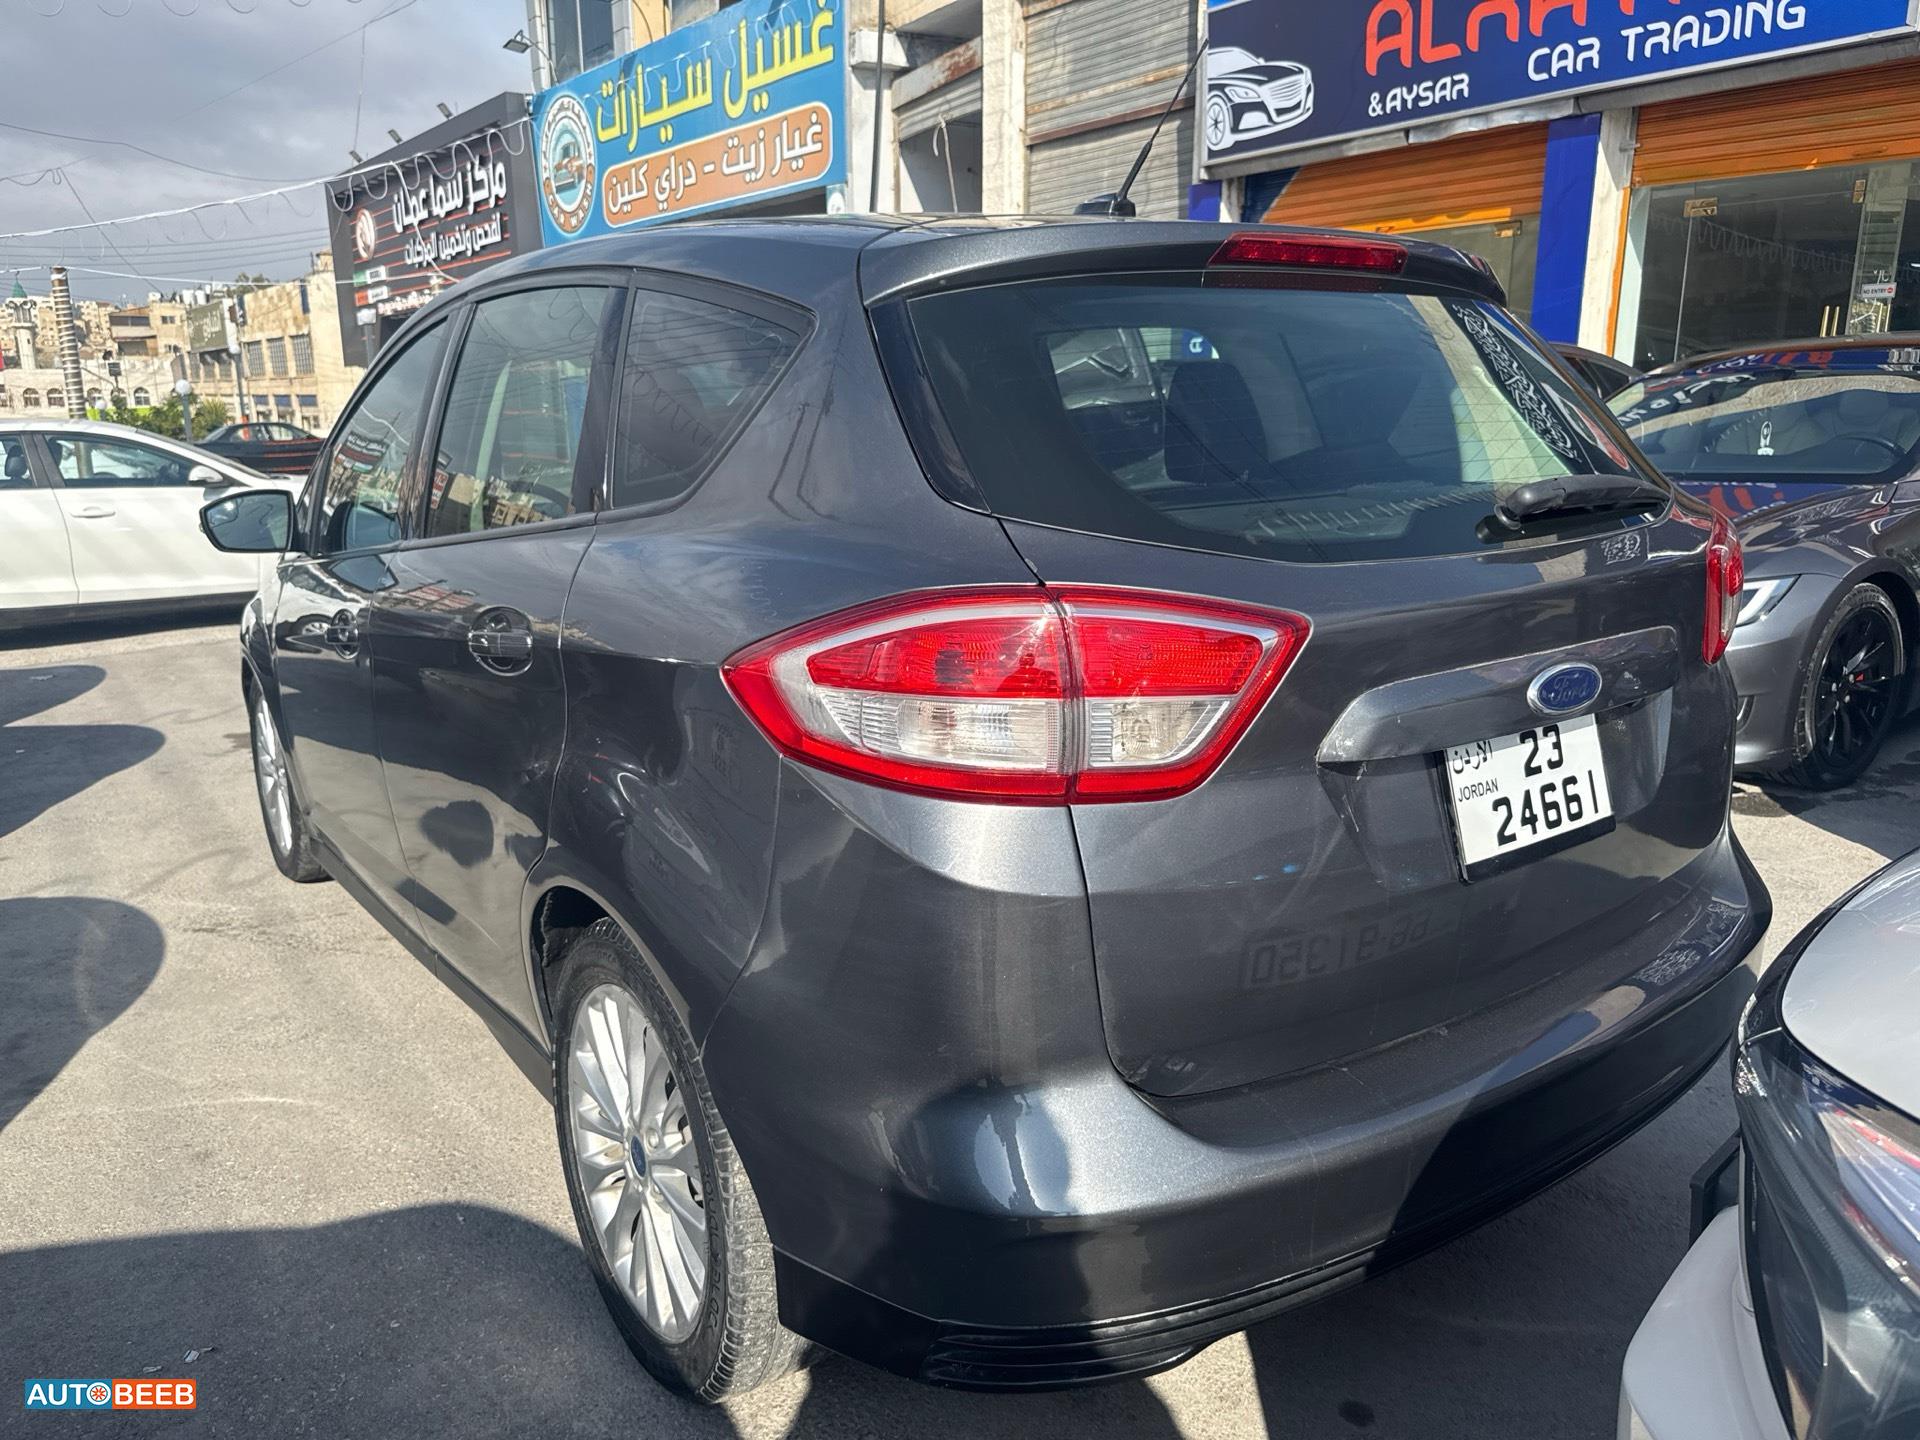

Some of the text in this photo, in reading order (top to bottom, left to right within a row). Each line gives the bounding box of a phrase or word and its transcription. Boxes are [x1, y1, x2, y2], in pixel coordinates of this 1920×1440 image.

[723, 0, 834, 119] غسيل
[1527, 0, 1806, 82] CAR TRADING
[595, 56, 713, 152] سيارات
[722, 127, 766, 183] زيت
[771, 111, 823, 177] غيار
[392, 156, 507, 233] مركز سما عمان
[549, 195, 564, 224] CAR
[607, 160, 649, 214] كلين
[654, 153, 697, 210] دراي
[1519, 723, 1564, 778] 23
[1458, 778, 1498, 802] JORDAN
[1492, 770, 1599, 847] 24661
